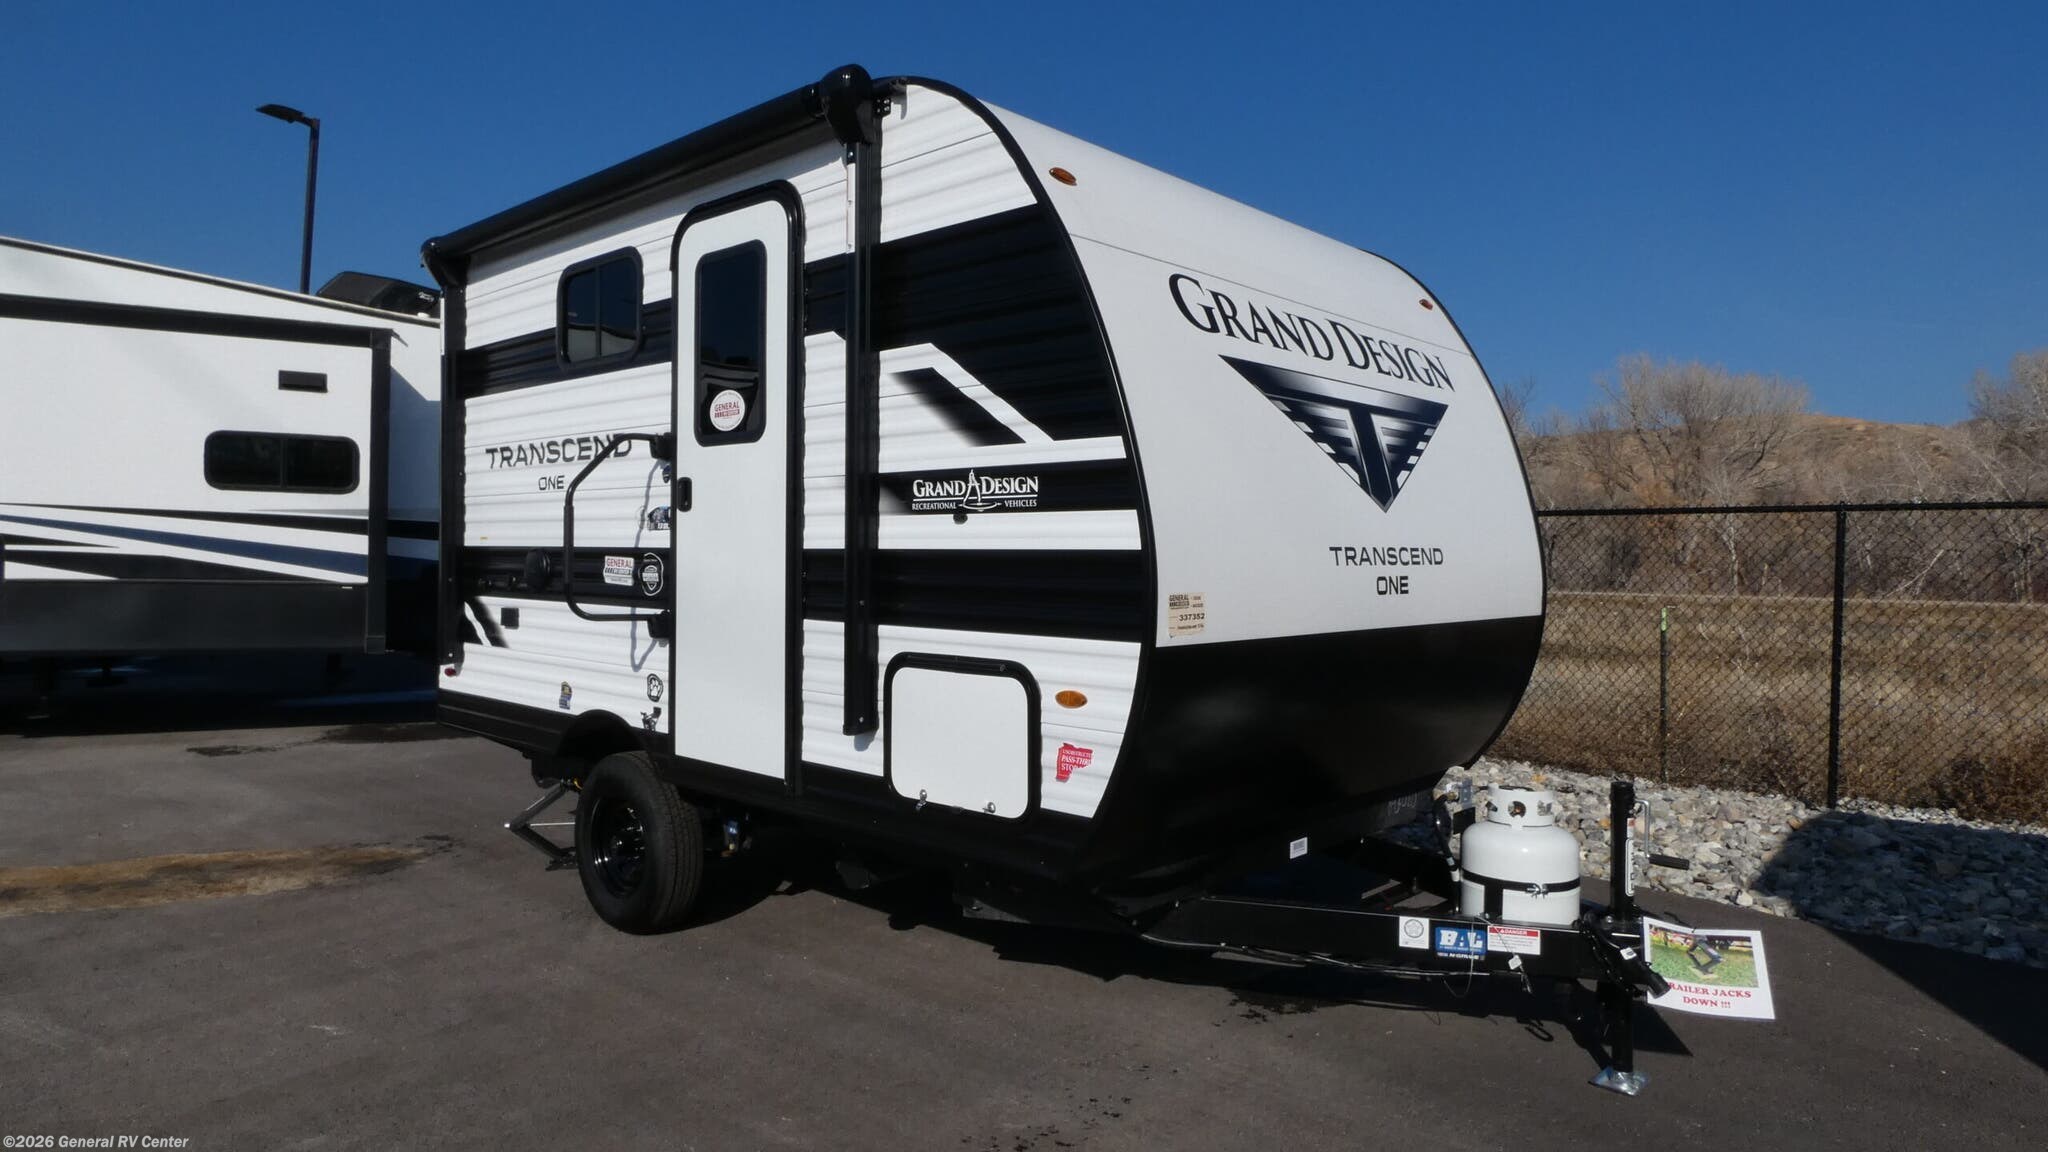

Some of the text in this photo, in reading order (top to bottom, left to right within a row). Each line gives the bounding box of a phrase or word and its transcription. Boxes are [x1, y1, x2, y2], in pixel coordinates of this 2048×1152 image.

[1168, 273, 1455, 392] GRAND DESIGN
[714, 401, 740, 411] GENERAL
[485, 433, 632, 469] TRANSCEND
[538, 475, 565, 491] ONE
[912, 476, 1039, 497] GRAND DESIGN
[912, 499, 1037, 511] RECREATIONAL VEHICLES
[606, 558, 633, 569] GENERAL
[1328, 546, 1444, 566] TRANSCEND
[1376, 576, 1409, 595] ONE
[1179, 611, 1206, 621] 337352
[1668, 981, 1752, 999] RAILER JACKS
[1683, 996, 1718, 1008] DOWN
